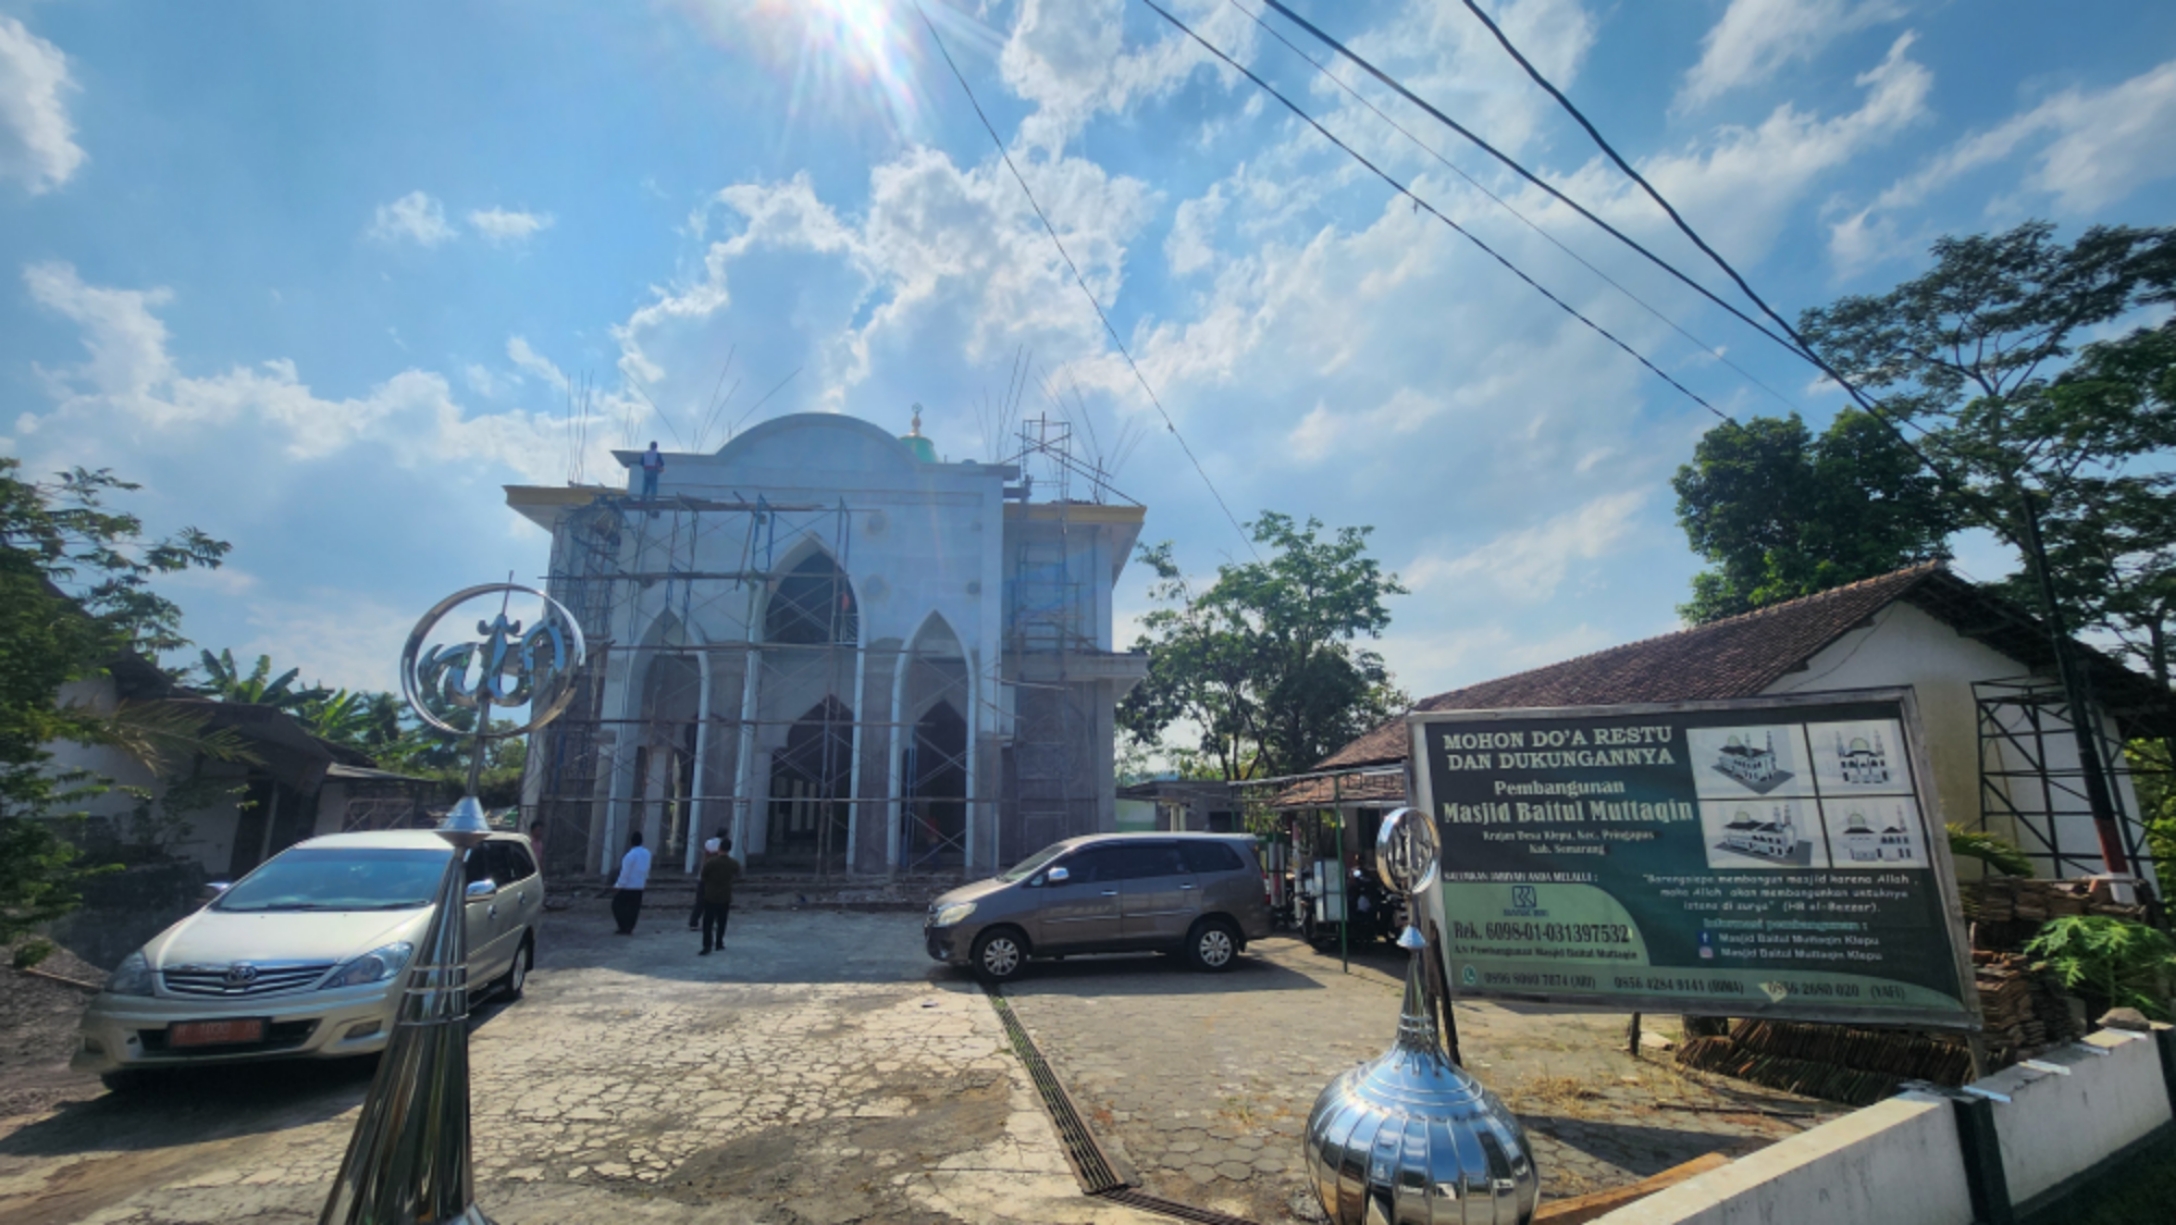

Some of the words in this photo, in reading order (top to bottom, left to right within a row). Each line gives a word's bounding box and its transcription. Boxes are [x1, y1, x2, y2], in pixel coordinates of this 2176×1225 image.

[1443, 732, 1524, 750] MOHON
[1532, 730, 1588, 747] DO'A
[1593, 726, 1672, 745] RESTU
[1447, 754, 1492, 771] DAN
[1499, 748, 1676, 769] DUKUNGANNYA
[1494, 780, 1625, 797] Pembangunan
[1443, 802, 1511, 825] Masjid
[1516, 800, 1585, 822] Baitul
[1590, 798, 1694, 823] Muttaqin
[1516, 830, 1542, 841] Desa
[1577, 830, 1600, 841] Kec.
[1529, 844, 1552, 854] Kab.
[1554, 844, 1605, 856] Semarang
[1528, 872, 1553, 882] ANDA
[1717, 874, 1784, 886] membangun
[1786, 874, 1826, 886] masjid
[1829, 874, 1873, 885] karena
[1877, 874, 1910, 885] Allah
[1692, 888, 1722, 898] Allah
[1729, 888, 1758, 898] akan
[1760, 888, 1849, 900] membangunkan
[1852, 888, 1909, 900] untuknya
[1722, 901, 1734, 911] di
[1453, 921, 1483, 940] Rek.
[1485, 922, 1631, 943] 6098-01-031397532
[1718, 933, 1755, 945] Masjid
[1757, 934, 1790, 944] Baitul
[1792, 934, 1842, 946] Muttaqin
[1844, 935, 1879, 947] Klepu
[1470, 945, 1533, 958] Pembangunan
[1535, 947, 1565, 959] Masjid
[1720, 948, 1757, 960] Masjid
[1759, 949, 1792, 959] Baitul
[1794, 949, 1844, 961] Muttaqin
[1846, 950, 1883, 962] Klepu
